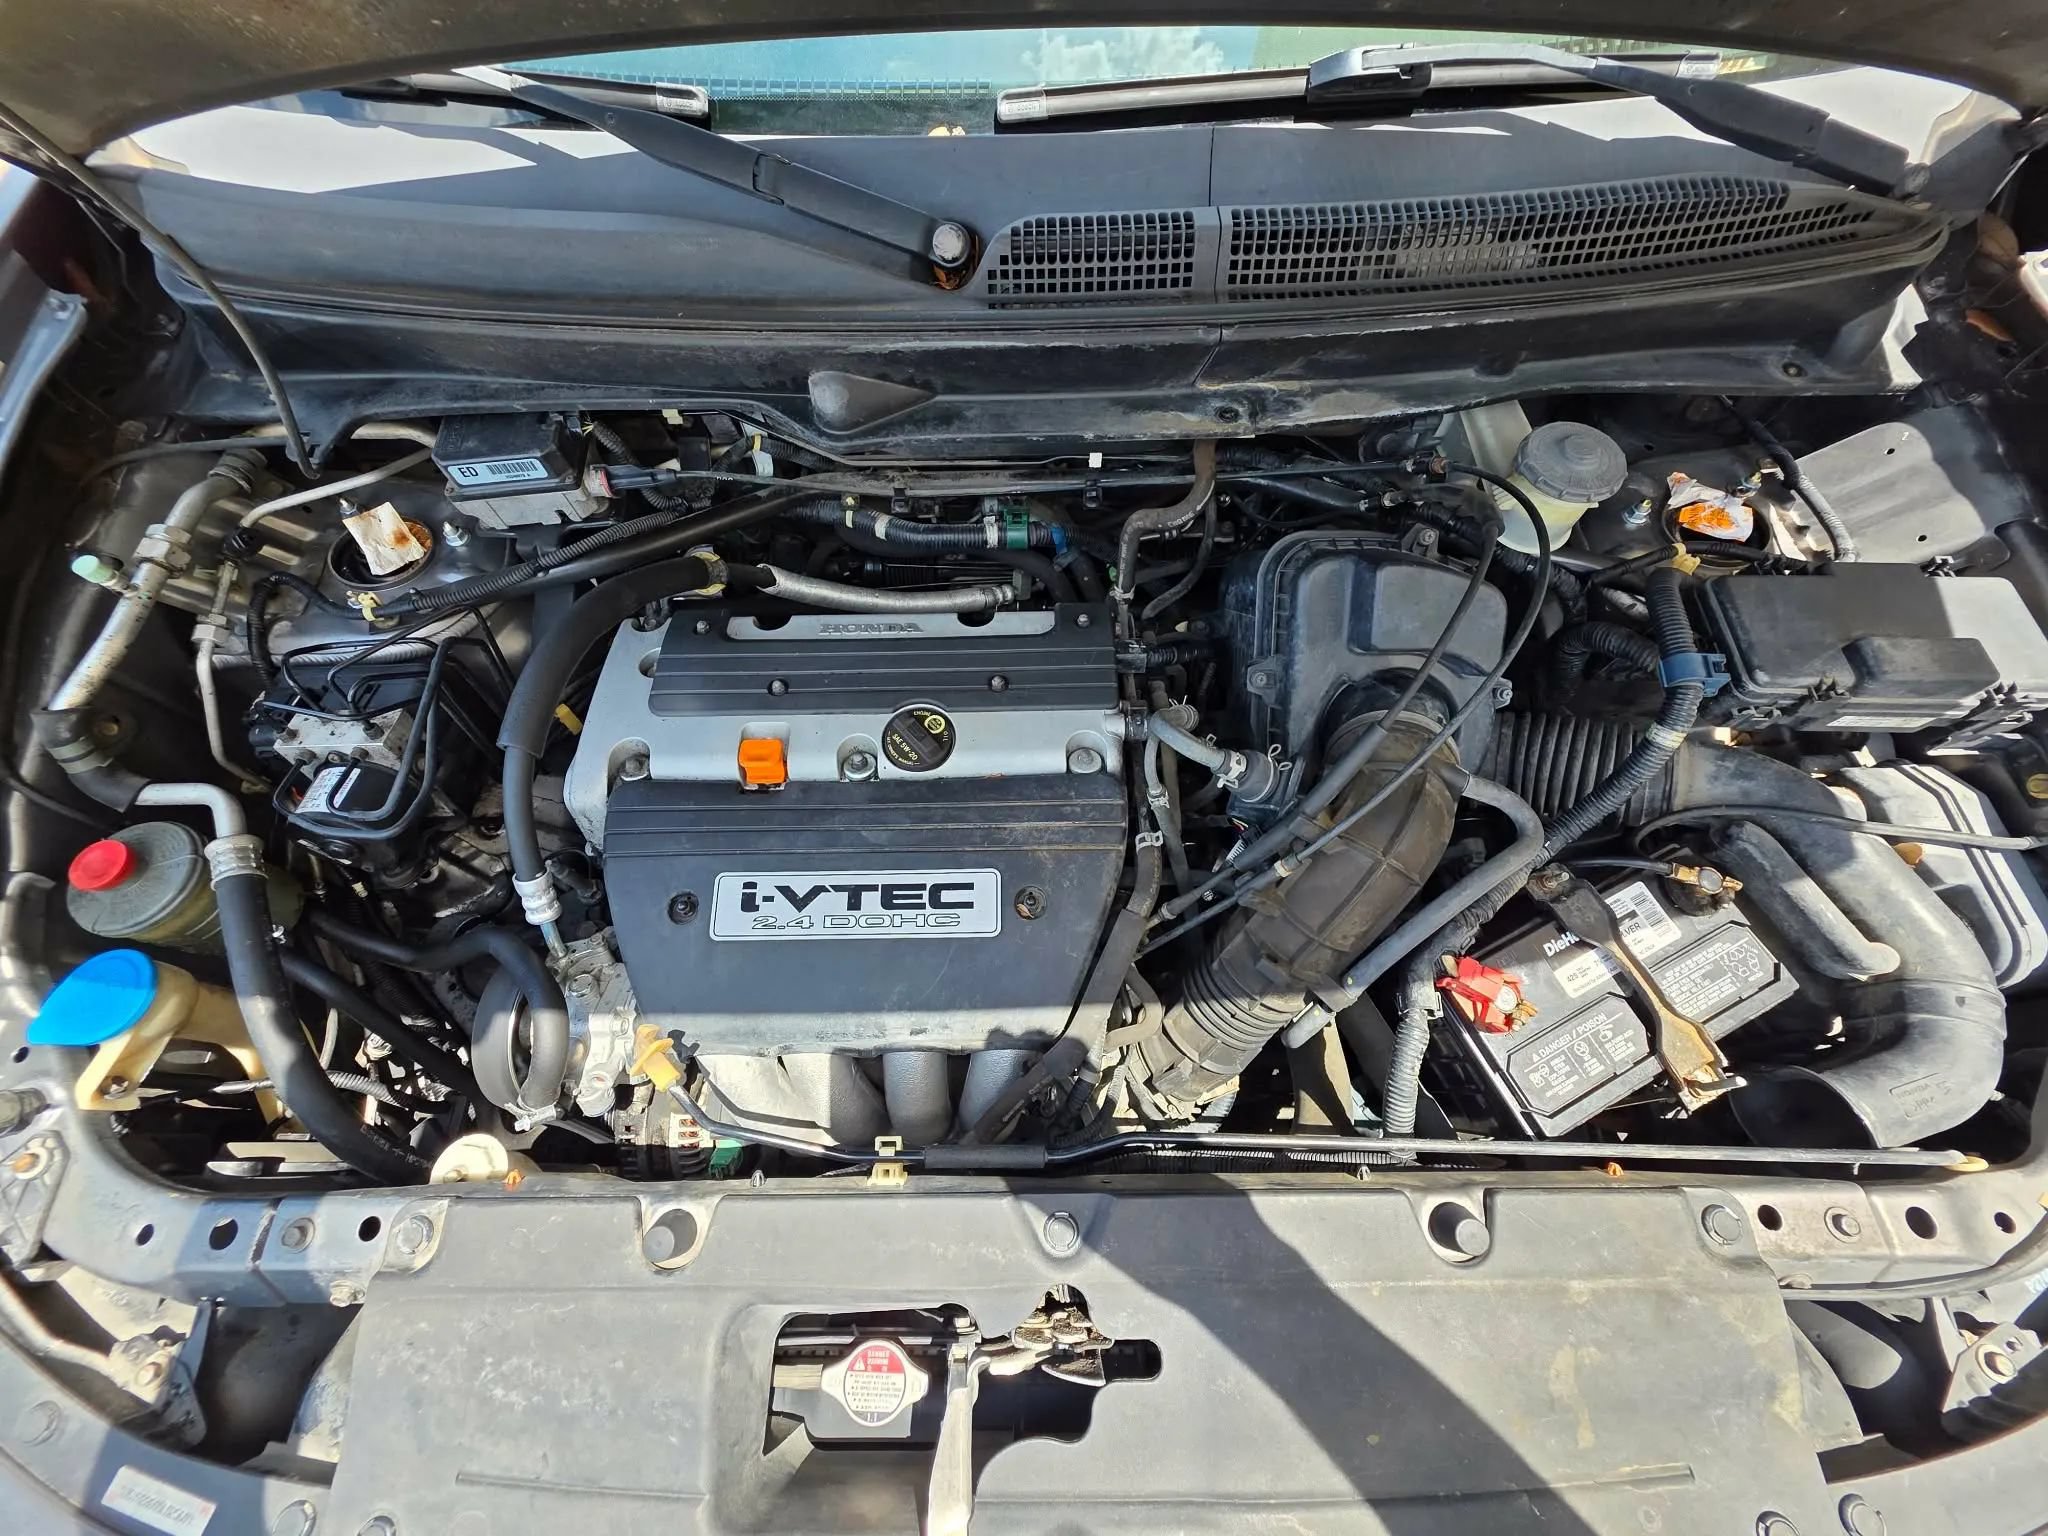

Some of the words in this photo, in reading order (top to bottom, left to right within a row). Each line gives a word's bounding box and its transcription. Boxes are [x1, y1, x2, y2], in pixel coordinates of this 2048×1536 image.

[458, 466, 479, 478] ED
[819, 623, 924, 635] HONDA
[892, 733, 904, 745] SAE
[900, 743, 918, 761] 5W-20
[740, 881, 975, 913] i-VTEC
[752, 915, 814, 930] 2.4
[823, 913, 961, 929] DOHC
[1620, 922, 1641, 938] LVER
[1539, 1034, 1573, 1057] DANGER
[1576, 1012, 1608, 1034] POISON
